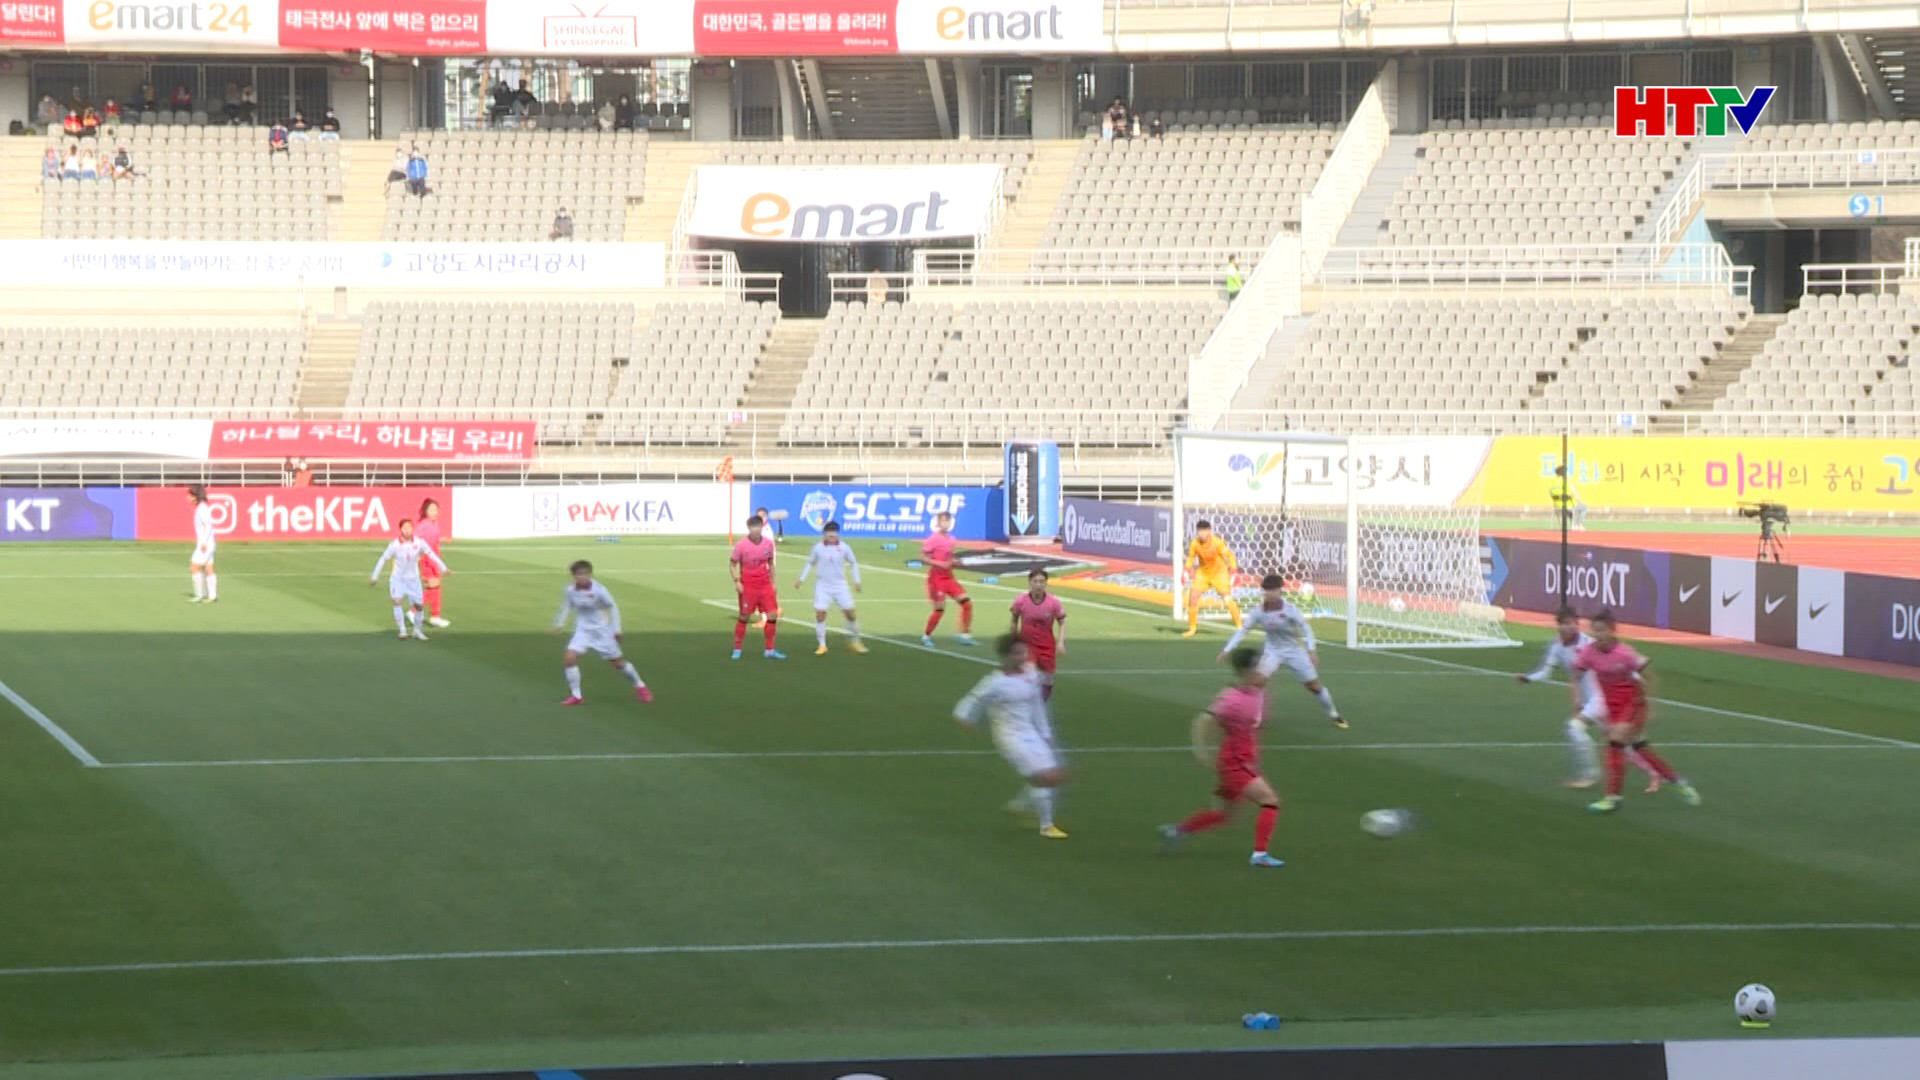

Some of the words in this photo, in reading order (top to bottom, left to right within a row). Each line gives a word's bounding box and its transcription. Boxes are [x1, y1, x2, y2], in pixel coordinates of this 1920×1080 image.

[285, 10, 351, 30] 태극전사
[356, 11, 389, 31] 앞에
[430, 13, 479, 33] 없으리
[702, 12, 768, 32] 대한민국,
[936, 5, 1063, 40] emart
[740, 191, 949, 239] emart
[404, 252, 586, 274] 고양도시관리공사
[376, 425, 455, 452] 하나된
[463, 429, 523, 452] 우리!
[1290, 454, 1431, 490] 고양시
[1640, 461, 1686, 487] 시작
[1705, 451, 1807, 497] 미래의
[1823, 463, 1865, 492] 중심
[1875, 456, 1920, 496] 고
[6, 498, 60, 532] KT
[248, 495, 391, 532] theKFA
[567, 500, 620, 522] PLAY
[625, 500, 674, 522] KFA
[1078, 515, 1151, 547] KoreaFootballTeam
[1602, 562, 1631, 607] KT
